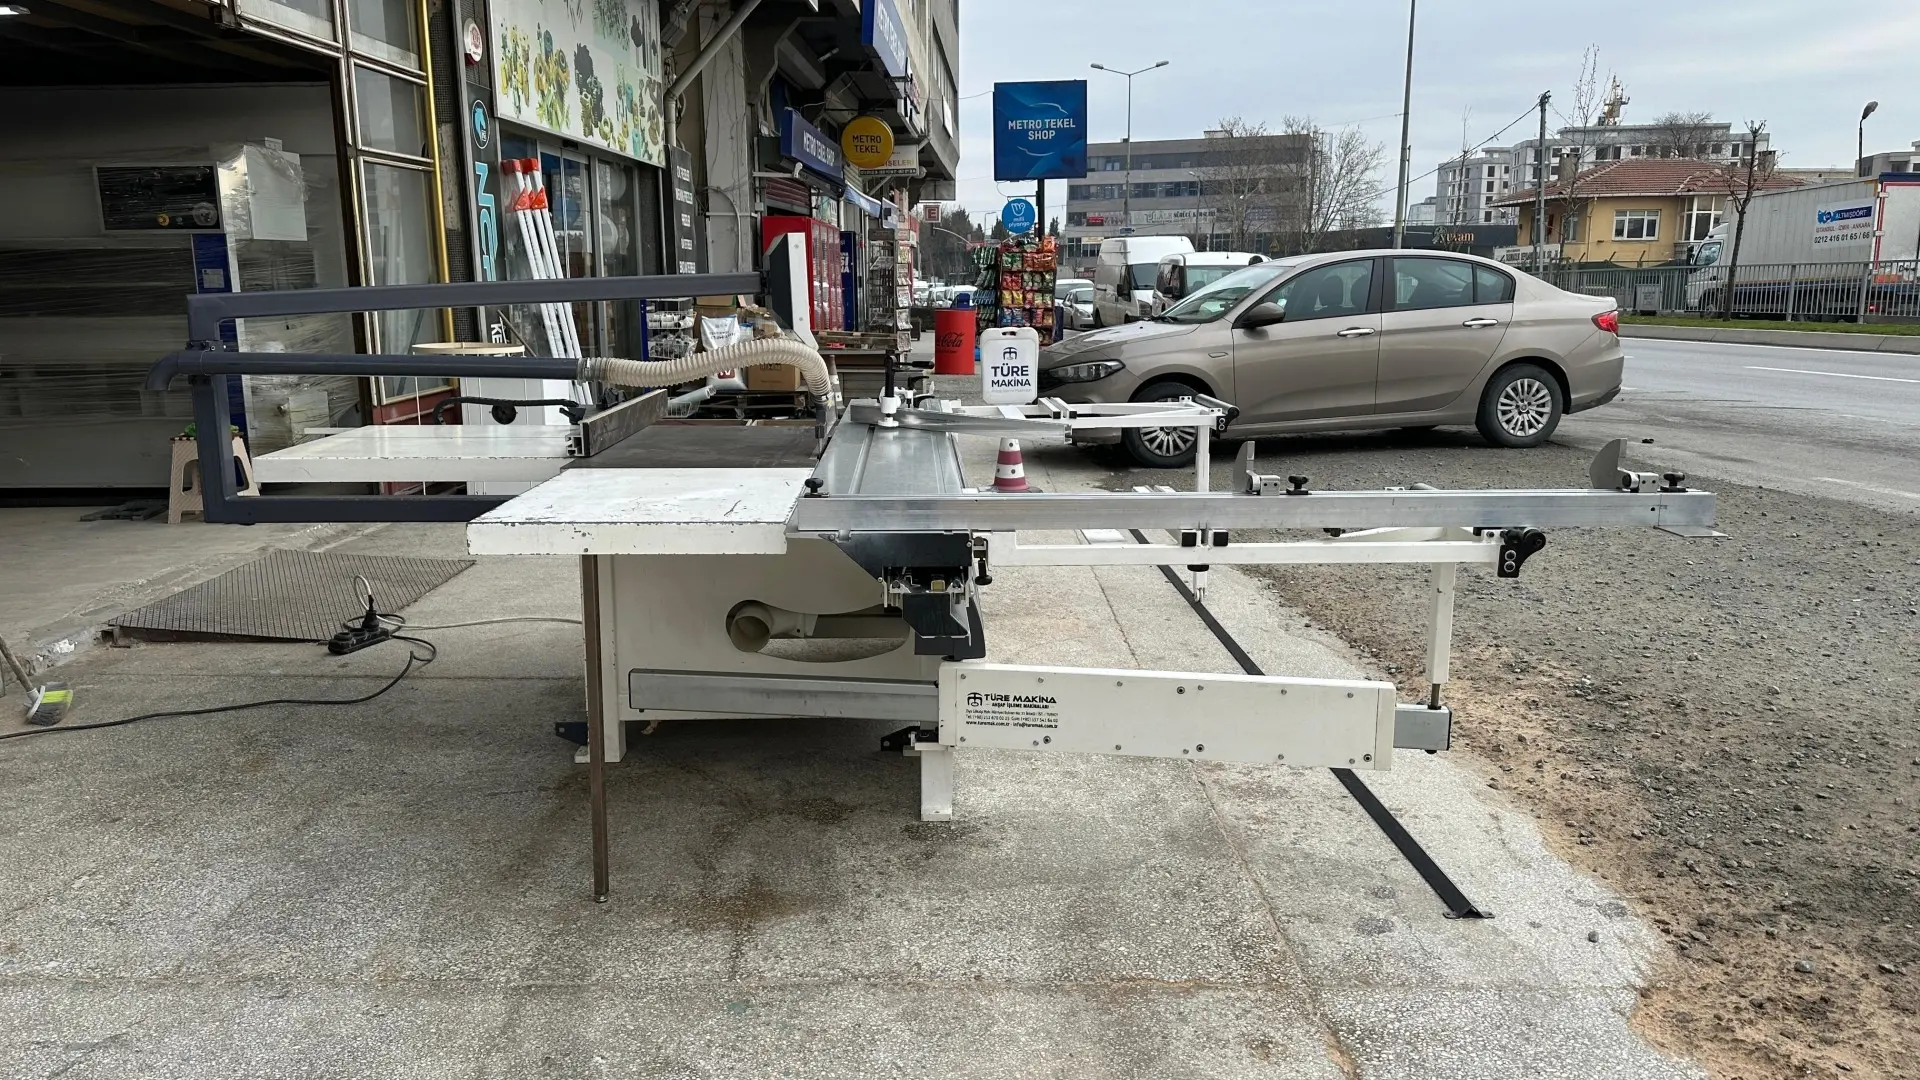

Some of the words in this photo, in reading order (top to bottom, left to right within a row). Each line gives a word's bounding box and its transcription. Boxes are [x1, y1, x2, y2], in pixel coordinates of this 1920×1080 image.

[1008, 120, 1042, 130] METRO
[1044, 118, 1076, 129] TEKEL
[852, 134, 881, 144] METRO
[1028, 130, 1056, 141] SHOP
[854, 144, 881, 154] TEKEL
[1835, 209, 1867, 219] ALTMIŞDÖRT
[1852, 221, 1871, 230] ANKARA
[1814, 235, 1828, 244] 0212
[1829, 234, 1840, 242] 416
[1841, 233, 1849, 241] 01
[1850, 232, 1858, 240] 65
[991, 363, 1029, 377] TÜRE
[991, 377, 1031, 388] MAKİNA
[984, 693, 1010, 702] TÜRE
[1012, 695, 1057, 704] MAKİNA
